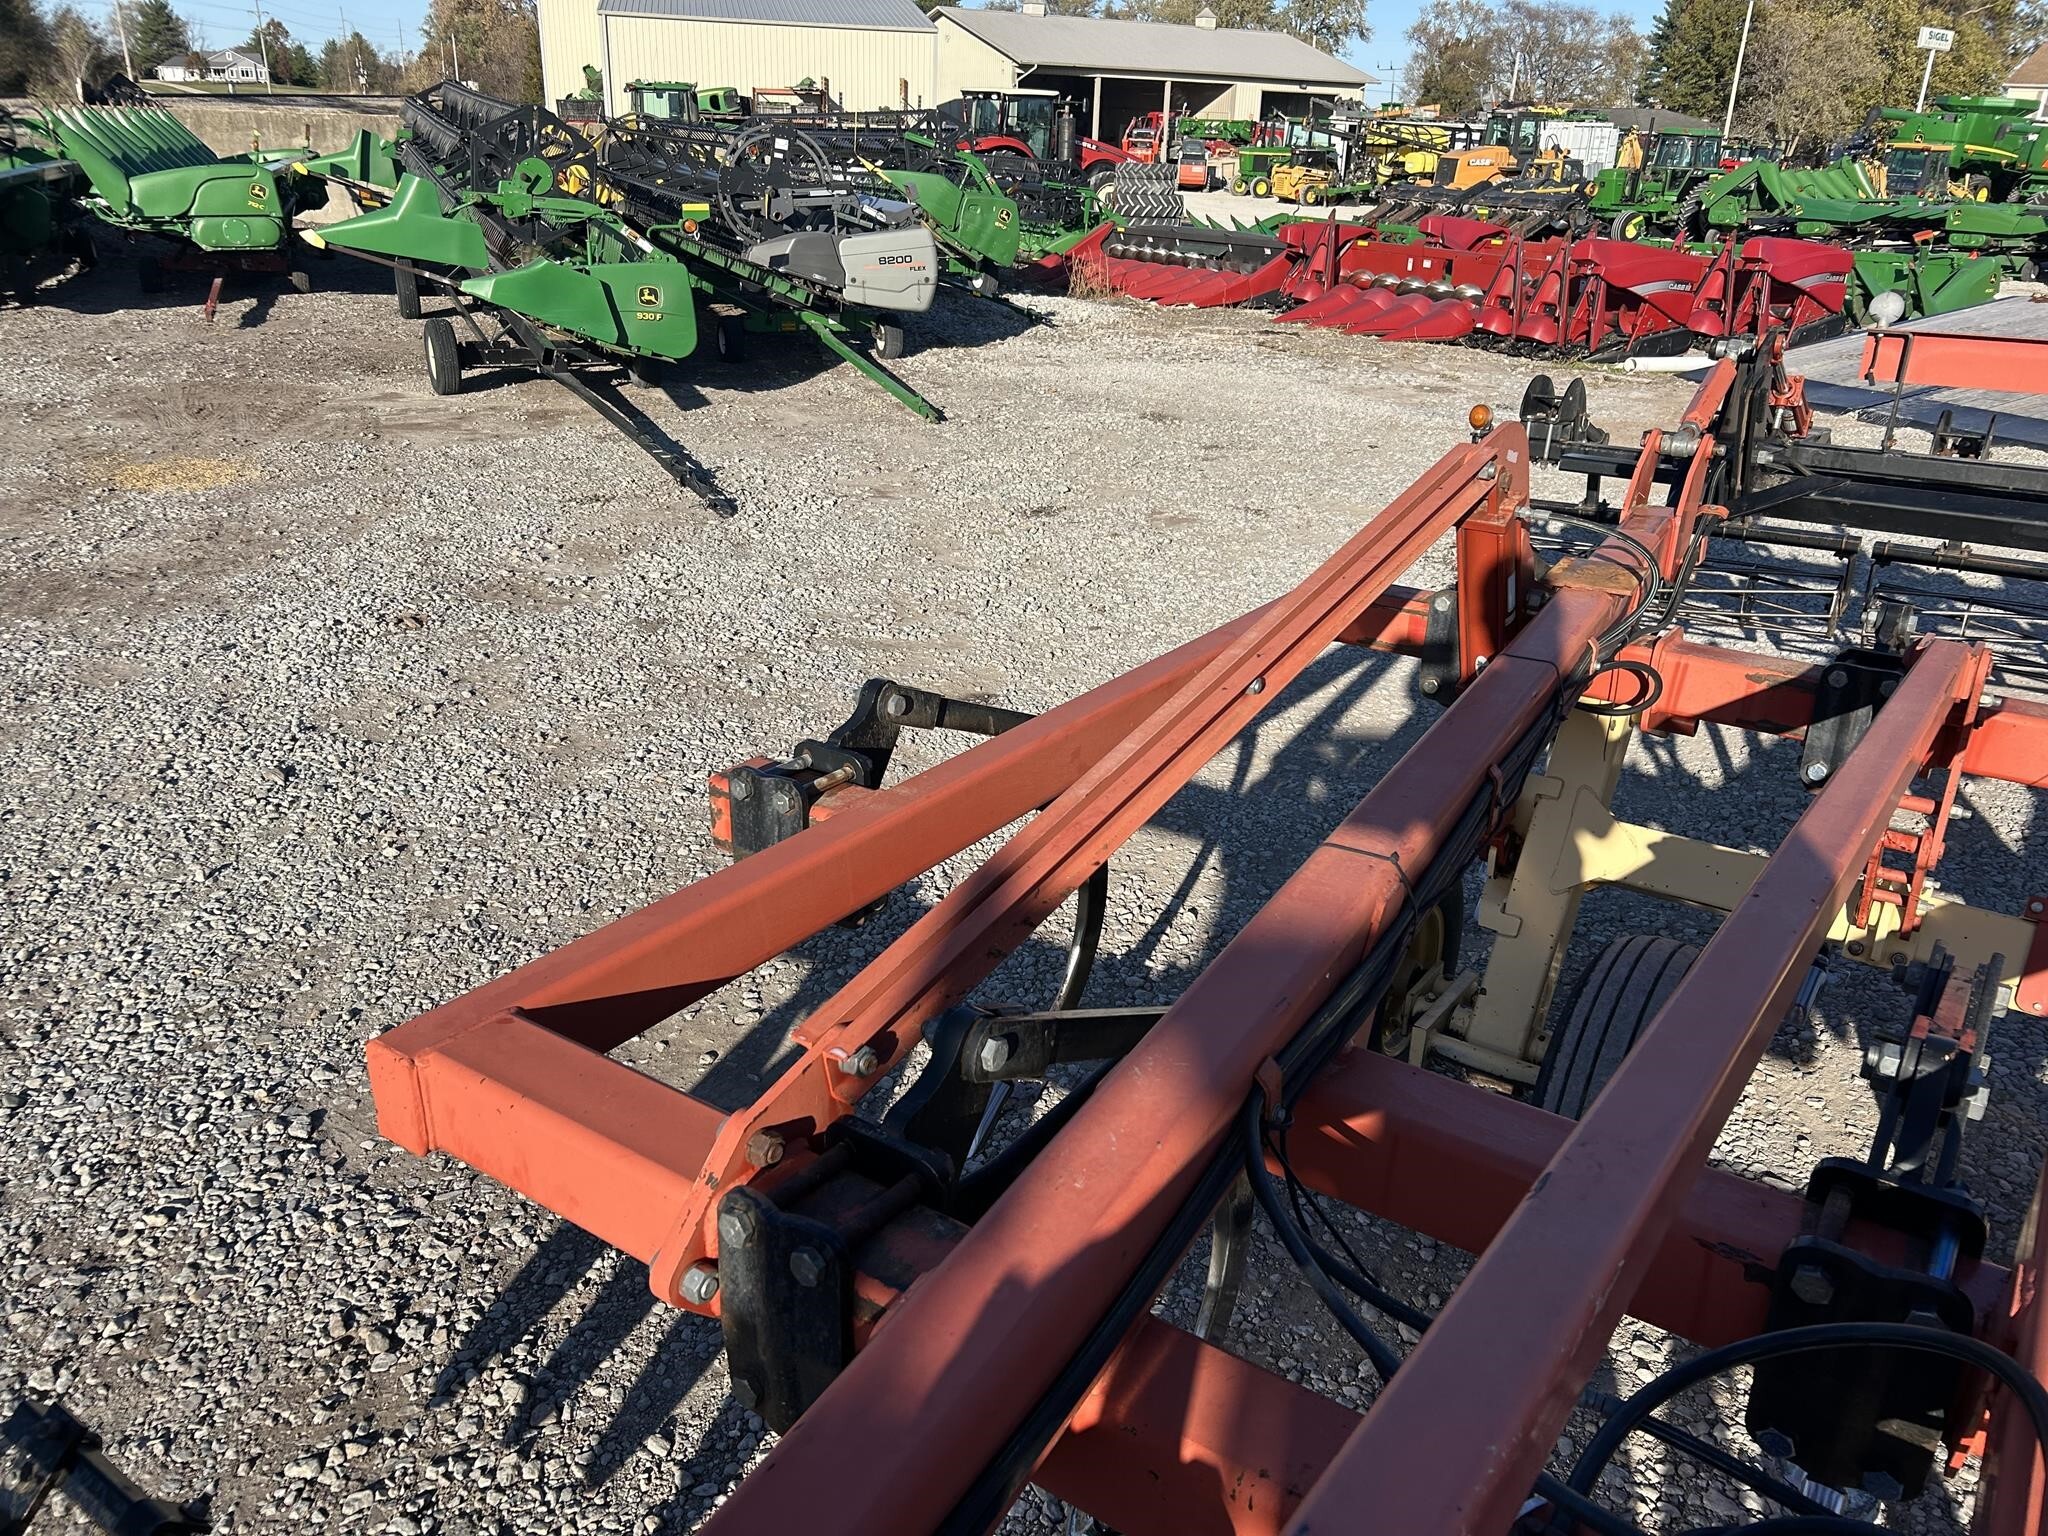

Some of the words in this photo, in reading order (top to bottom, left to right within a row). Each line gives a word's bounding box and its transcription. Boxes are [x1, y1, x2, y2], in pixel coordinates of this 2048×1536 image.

[1928, 31, 1949, 42] SIGEL
[878, 255, 912, 265] 8200
[1668, 283, 1685, 291] CASE
[636, 312, 655, 320] 930
[656, 313, 663, 321] F
